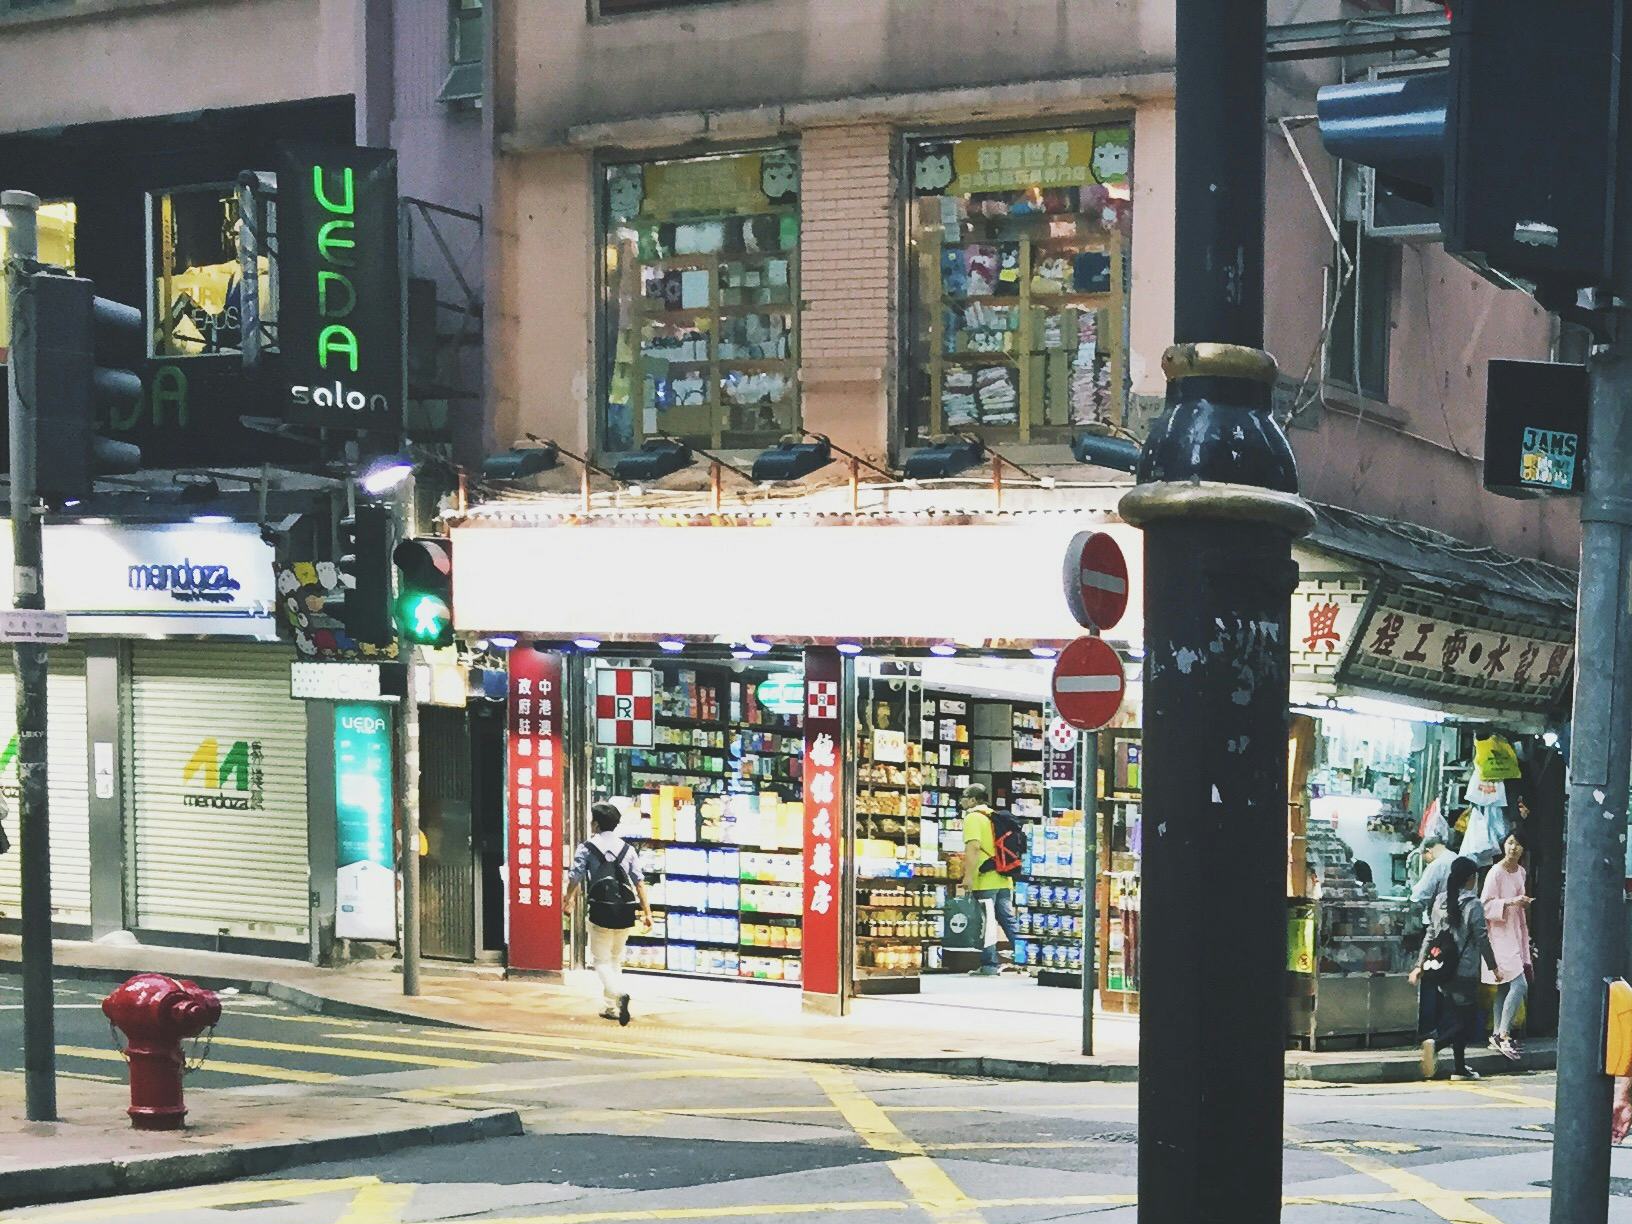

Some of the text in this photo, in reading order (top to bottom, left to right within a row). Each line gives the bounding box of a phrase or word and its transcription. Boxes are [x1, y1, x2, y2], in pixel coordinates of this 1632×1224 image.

[313, 166, 358, 371] UEDA
[291, 381, 388, 410] salon
[1523, 430, 1577, 457] JAMS
[128, 557, 230, 591] mendoza
[341, 717, 386, 730] UEDA
[184, 793, 249, 811] mendoza
